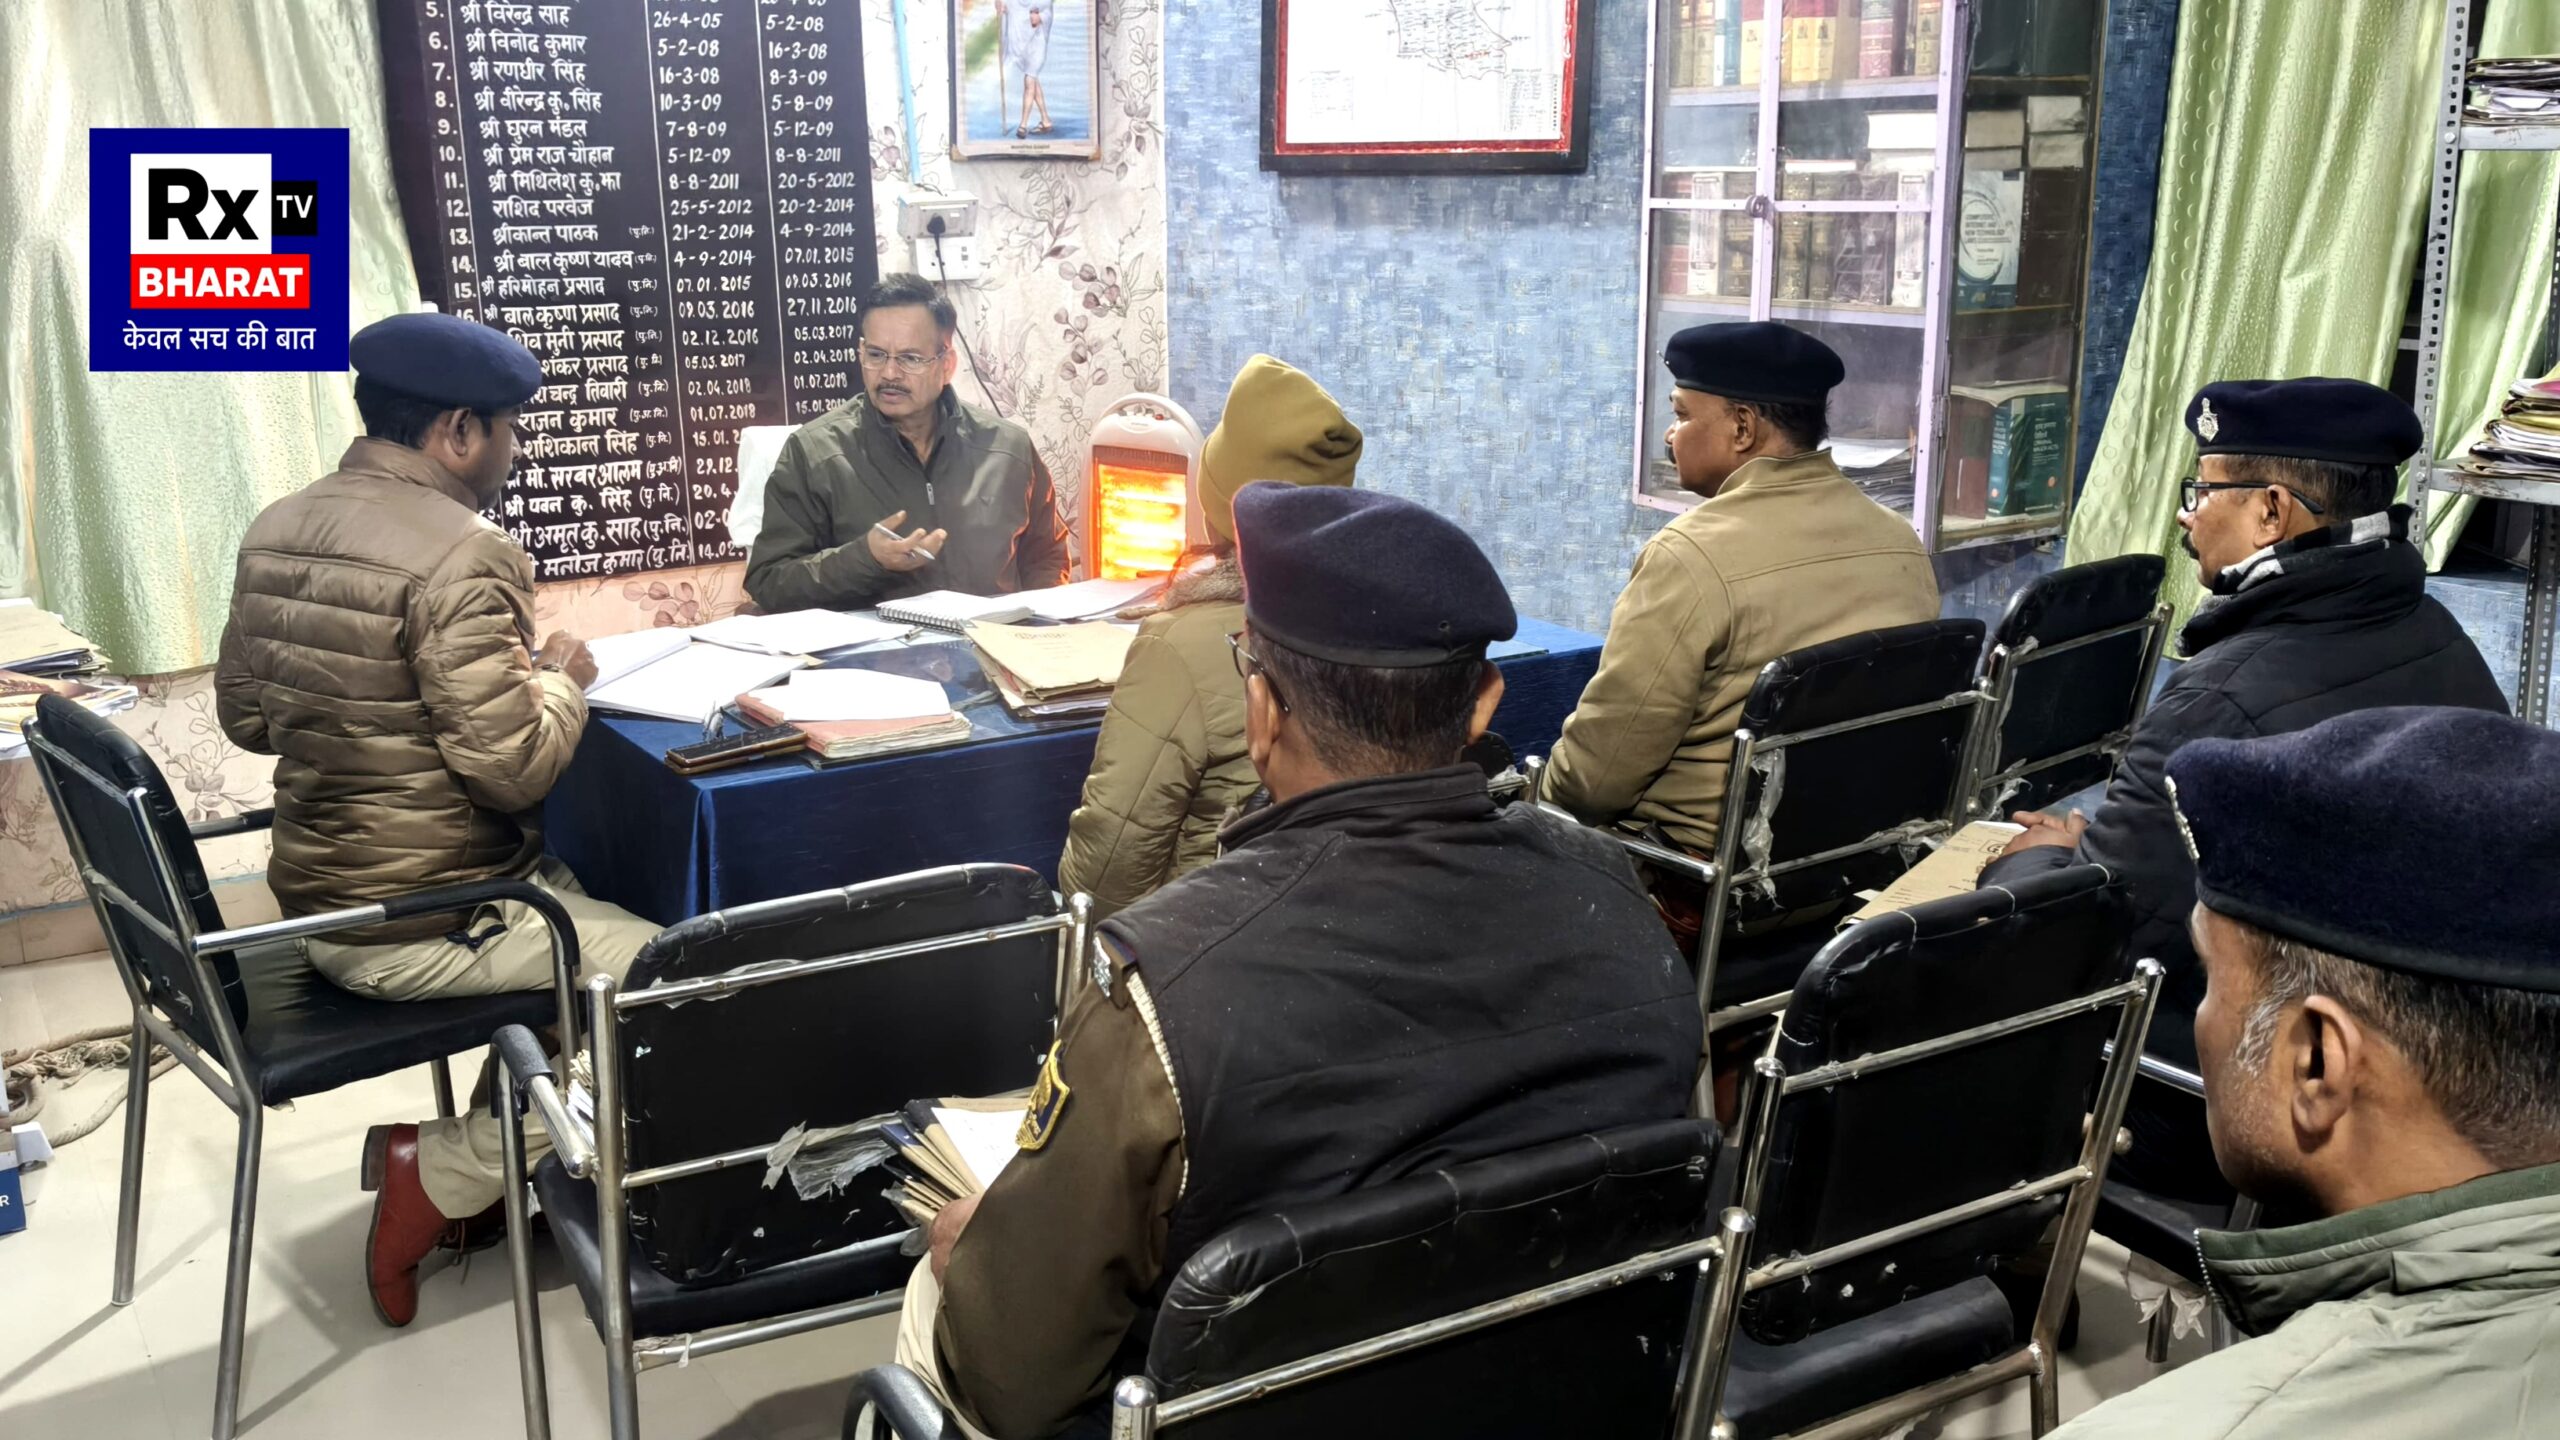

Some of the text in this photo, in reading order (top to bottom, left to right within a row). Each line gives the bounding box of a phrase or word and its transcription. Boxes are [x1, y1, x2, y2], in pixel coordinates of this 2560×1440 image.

[426, 1, 444, 18] 5.
[460, 0, 481, 24] श्री
[538, 5, 571, 27] साह
[654, 11, 723, 29] 26-4-05
[765, 14, 824, 32] 5-2-08
[428, 28, 828, 59] 6. श्री विनोद कुमार 5-2-08 16-3-08
[432, 56, 828, 86] 7. श्री रणधीर सिंह 16-3-08 8-3-09
[435, 91, 454, 108] 8.
[474, 86, 495, 112] श्री
[500, 85, 546, 111] वीरेन्द्र
[569, 87, 603, 114] सिंह
[660, 93, 722, 112] 10-3-09
[771, 94, 833, 111] 5-8-09
[438, 115, 834, 145] 9. श्री घुरन मंडल 7-8-09 5-12-09
[439, 146, 462, 162] 10.
[483, 143, 503, 167] श्री
[536, 147, 566, 165] राज
[568, 141, 615, 168] चौहान
[667, 148, 731, 164] 5-12-09
[775, 147, 841, 163] 8-8-2011
[444, 172, 465, 189] 11.
[488, 168, 508, 193] श्री
[511, 168, 577, 193] मिथिलेश
[669, 173, 739, 190] 8-8-2011
[778, 172, 856, 189] 20-5-2012
[446, 194, 855, 218] 12. राशिद परवेज 25-5-2012 20-2-2014
[449, 228, 472, 246] 13.
[554, 225, 599, 244] पाठक
[780, 222, 855, 238] 4-9-2014
[451, 256, 476, 274] 14.
[494, 249, 515, 273] श्री
[517, 253, 552, 271] बाल
[553, 251, 591, 276] कृष्ण
[593, 251, 634, 269] यादव
[674, 250, 756, 268] 4-9-2014
[785, 247, 855, 264] 07.01.2015
[454, 282, 477, 299] 15.
[481, 275, 495, 297] श्री
[498, 274, 560, 299] हरिमोहन
[562, 277, 605, 296] प्रसाद
[501, 307, 534, 326] बाल
[536, 304, 577, 329] कृष्ण
[579, 303, 621, 324] प्रसाद
[787, 296, 857, 317] 27.11.2016
[546, 325, 575, 356] मुनी
[579, 330, 625, 351] प्रसाद
[682, 328, 759, 346] 02.12.2016
[794, 325, 854, 341] 05.03.2017
[584, 355, 629, 375] प्रसाद
[793, 348, 856, 365] 02.04.2018
[585, 376, 628, 402] तिवारी
[688, 378, 751, 396] 02.04.2018
[518, 410, 564, 432] राजन
[569, 407, 618, 432] कुमार
[690, 403, 756, 422] 01.07.2018
[604, 429, 640, 456] सिंह
[550, 464, 597, 490] सरवर
[598, 460, 643, 487] आलम
[505, 494, 525, 517] श्री
[529, 496, 564, 514] पवन
[599, 486, 632, 513] सिंह
[534, 523, 580, 553] अमृत
[606, 517, 642, 545] साह
[543, 550, 602, 576] मनोज
[603, 549, 645, 574] कुमार
